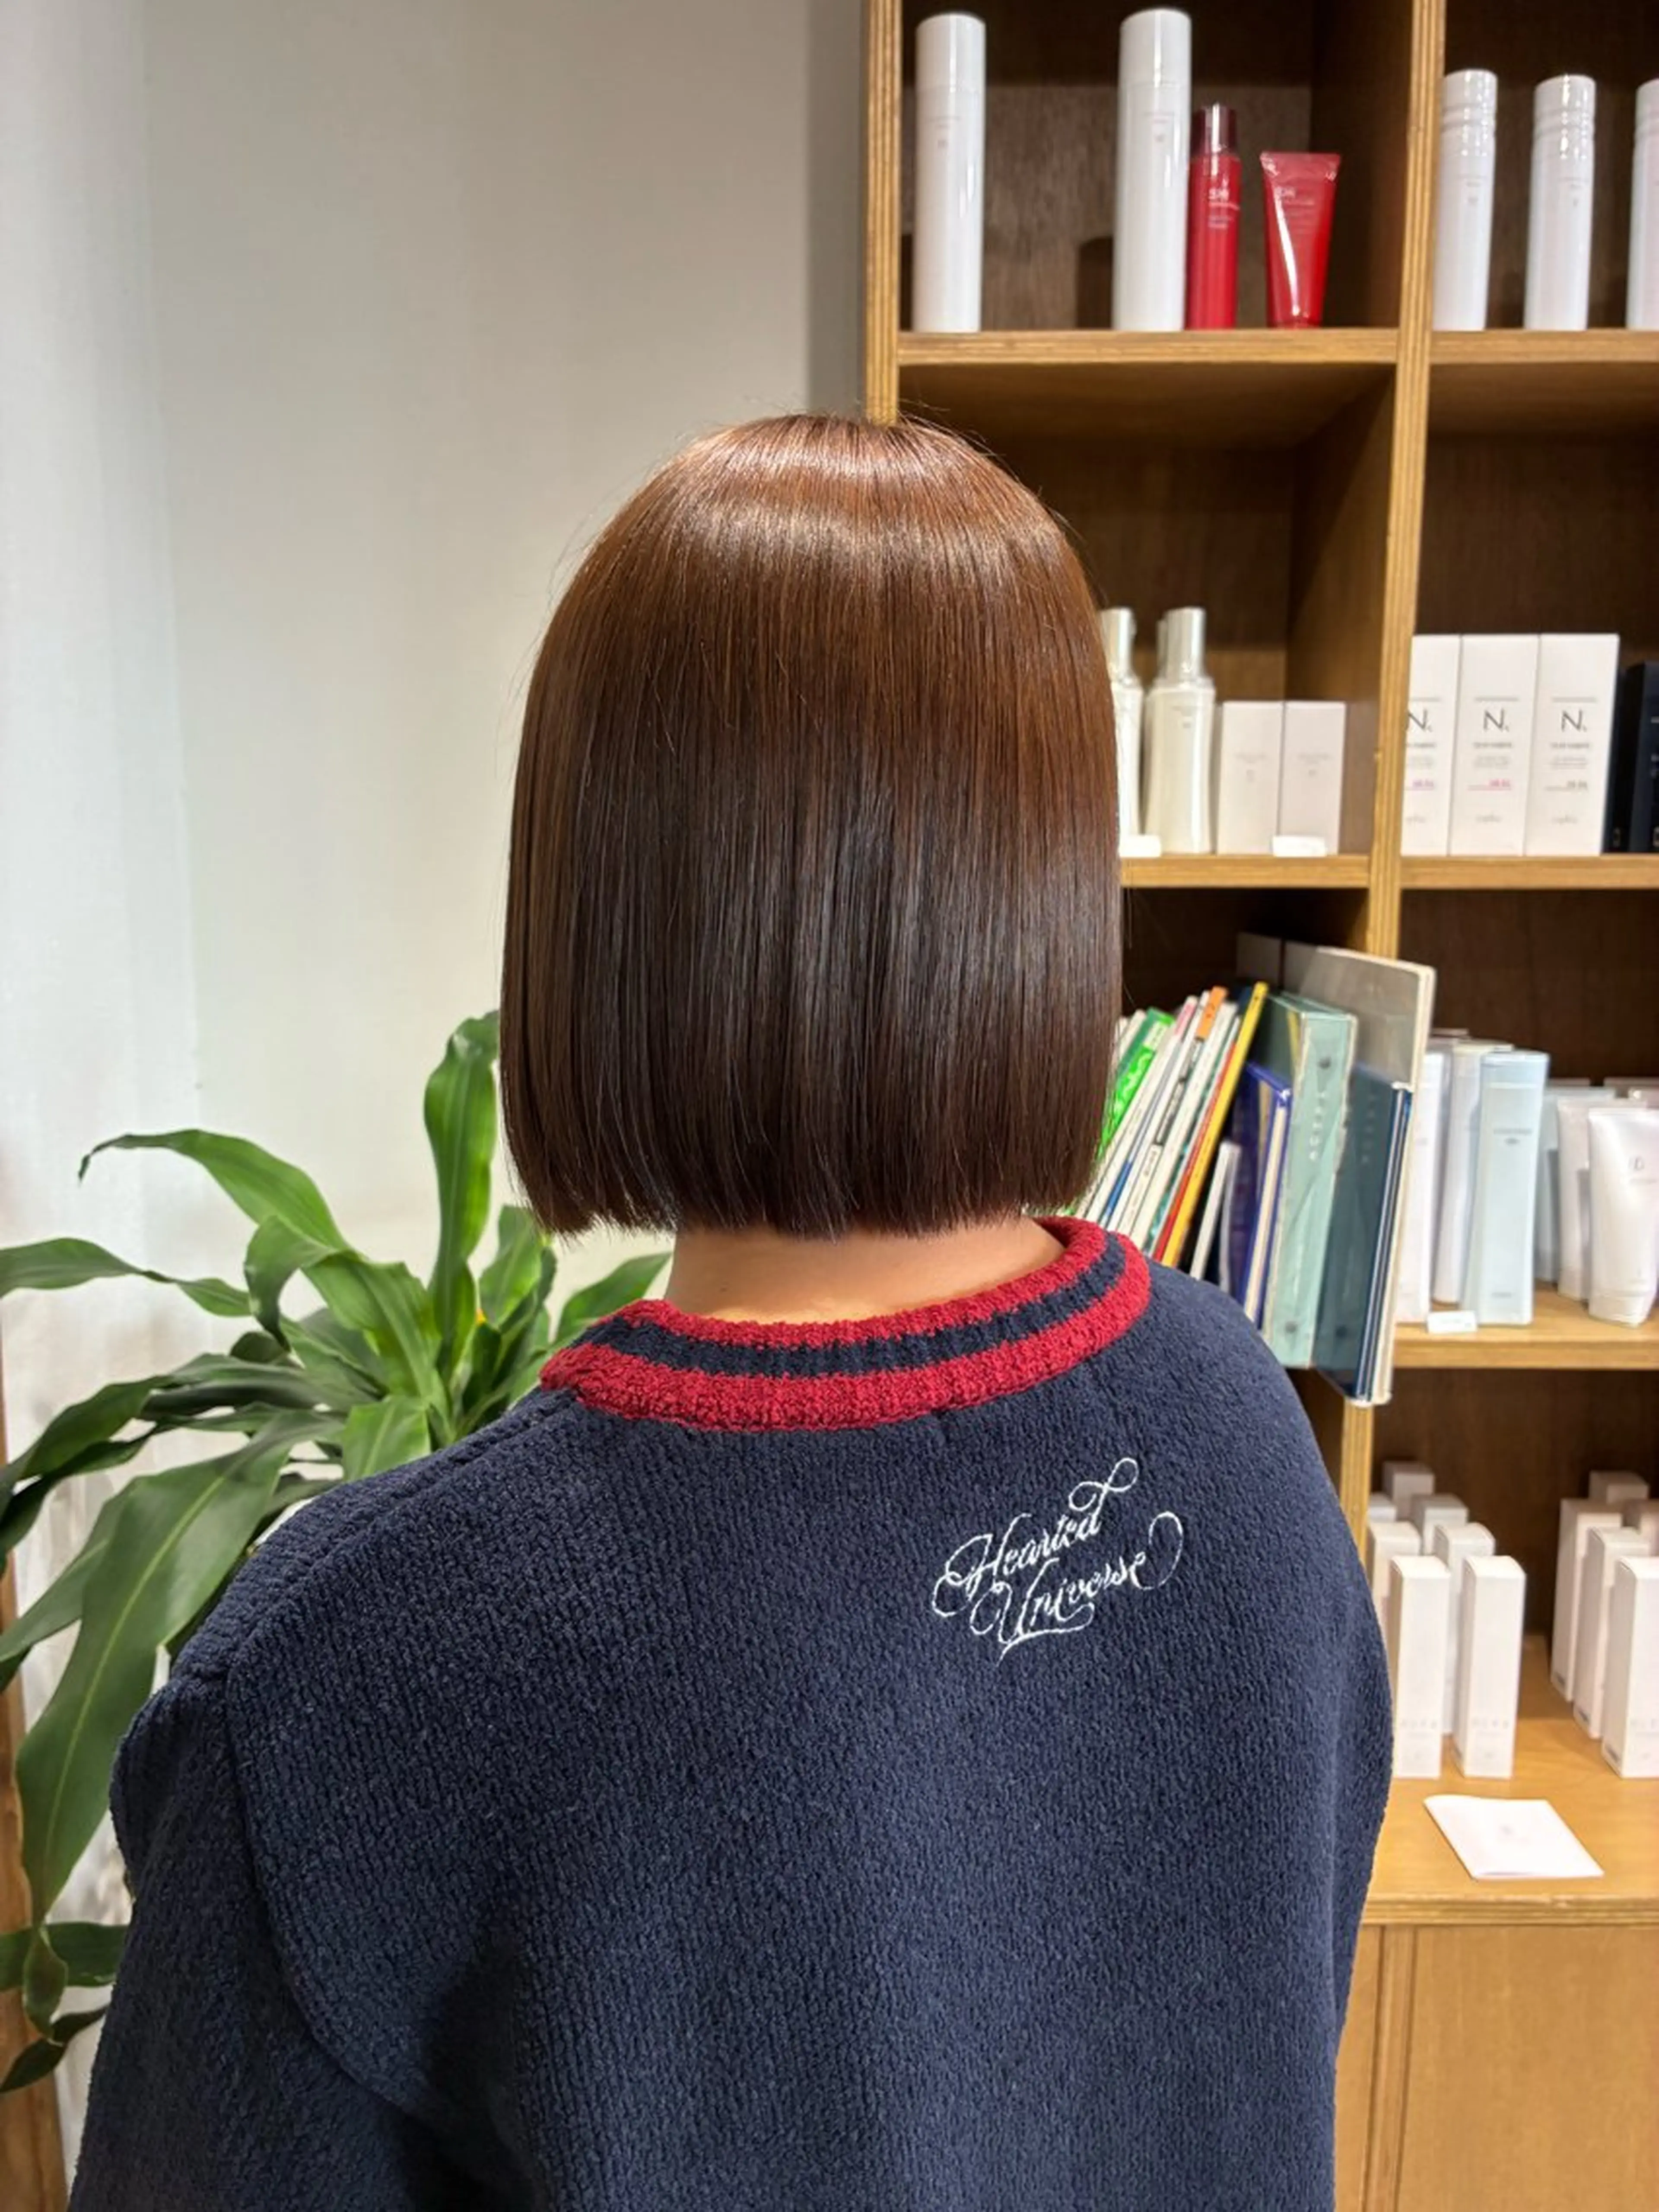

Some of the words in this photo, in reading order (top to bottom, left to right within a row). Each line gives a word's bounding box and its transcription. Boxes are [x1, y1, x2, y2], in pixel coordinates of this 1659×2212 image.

[1483, 708, 1510, 732] N.
[1560, 709, 1587, 732] N.
[931, 1457, 1139, 1617] Hearted
[969, 1511, 1184, 1667] Universe
